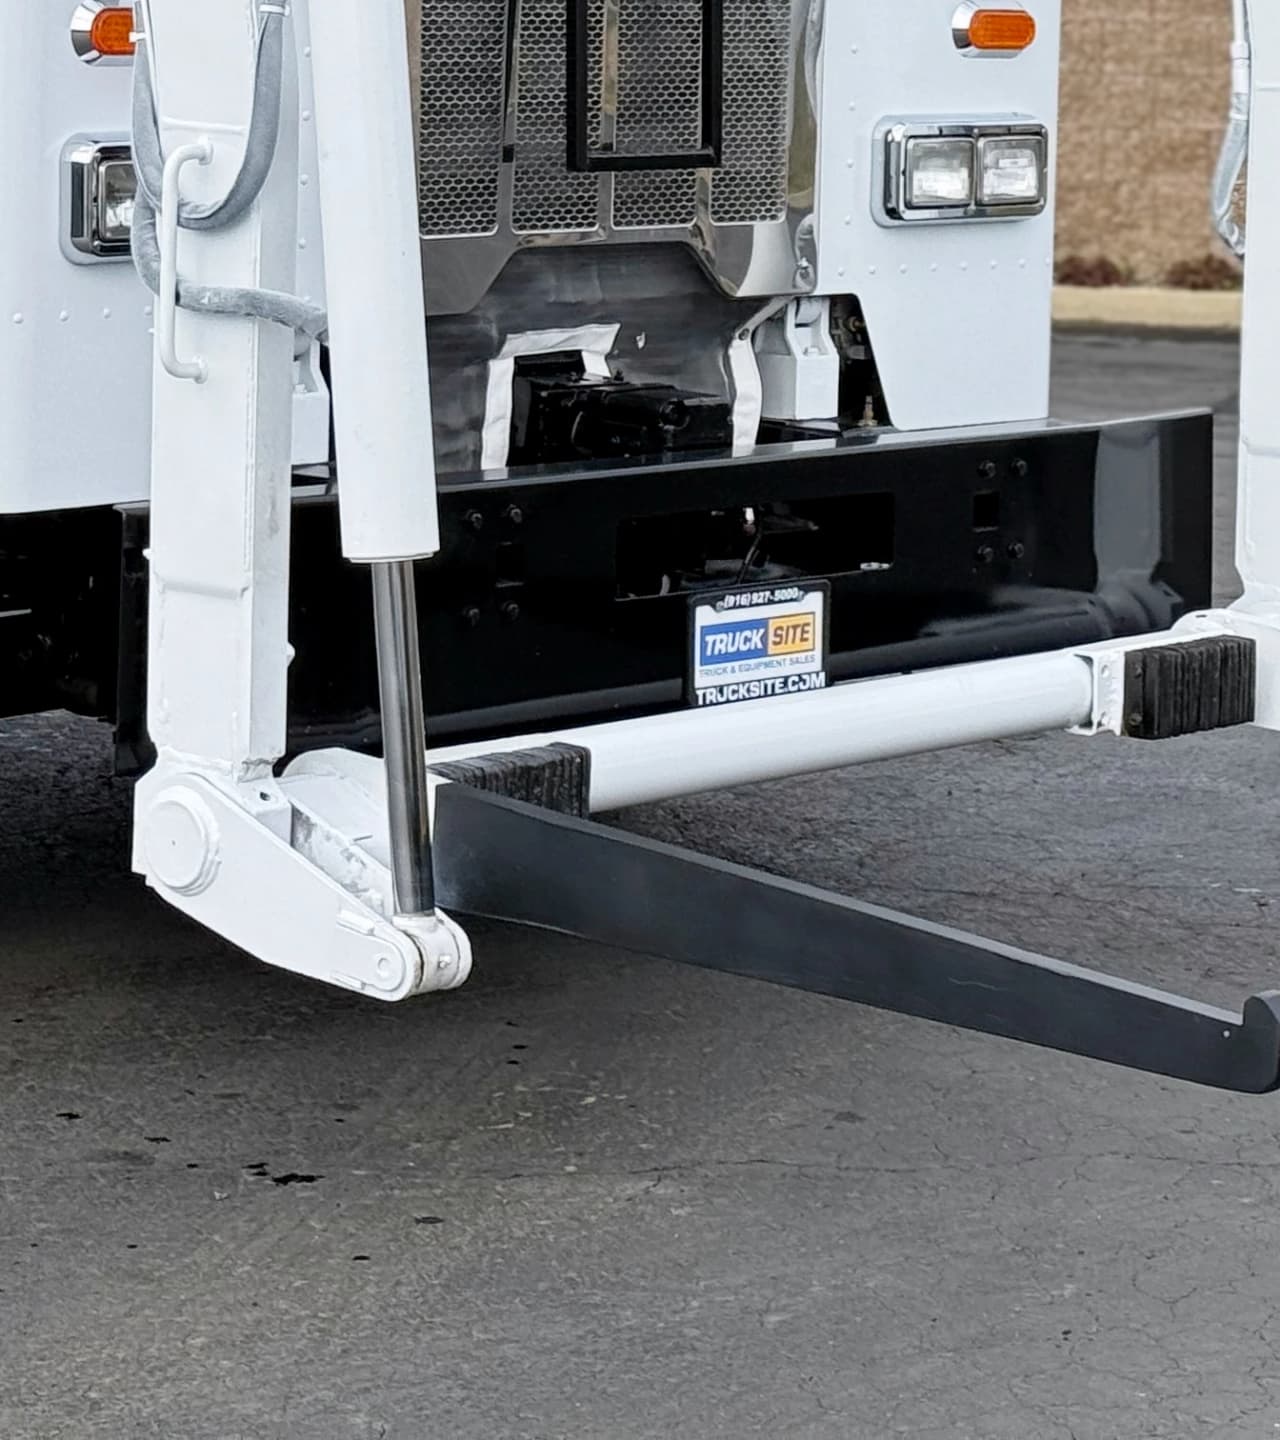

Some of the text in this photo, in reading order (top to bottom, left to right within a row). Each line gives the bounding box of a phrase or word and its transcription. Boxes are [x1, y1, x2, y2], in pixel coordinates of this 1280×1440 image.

[705, 623, 811, 656] TRUCK SITE
[699, 654, 816, 677] TRUCK & EQUIPMENT SALES
